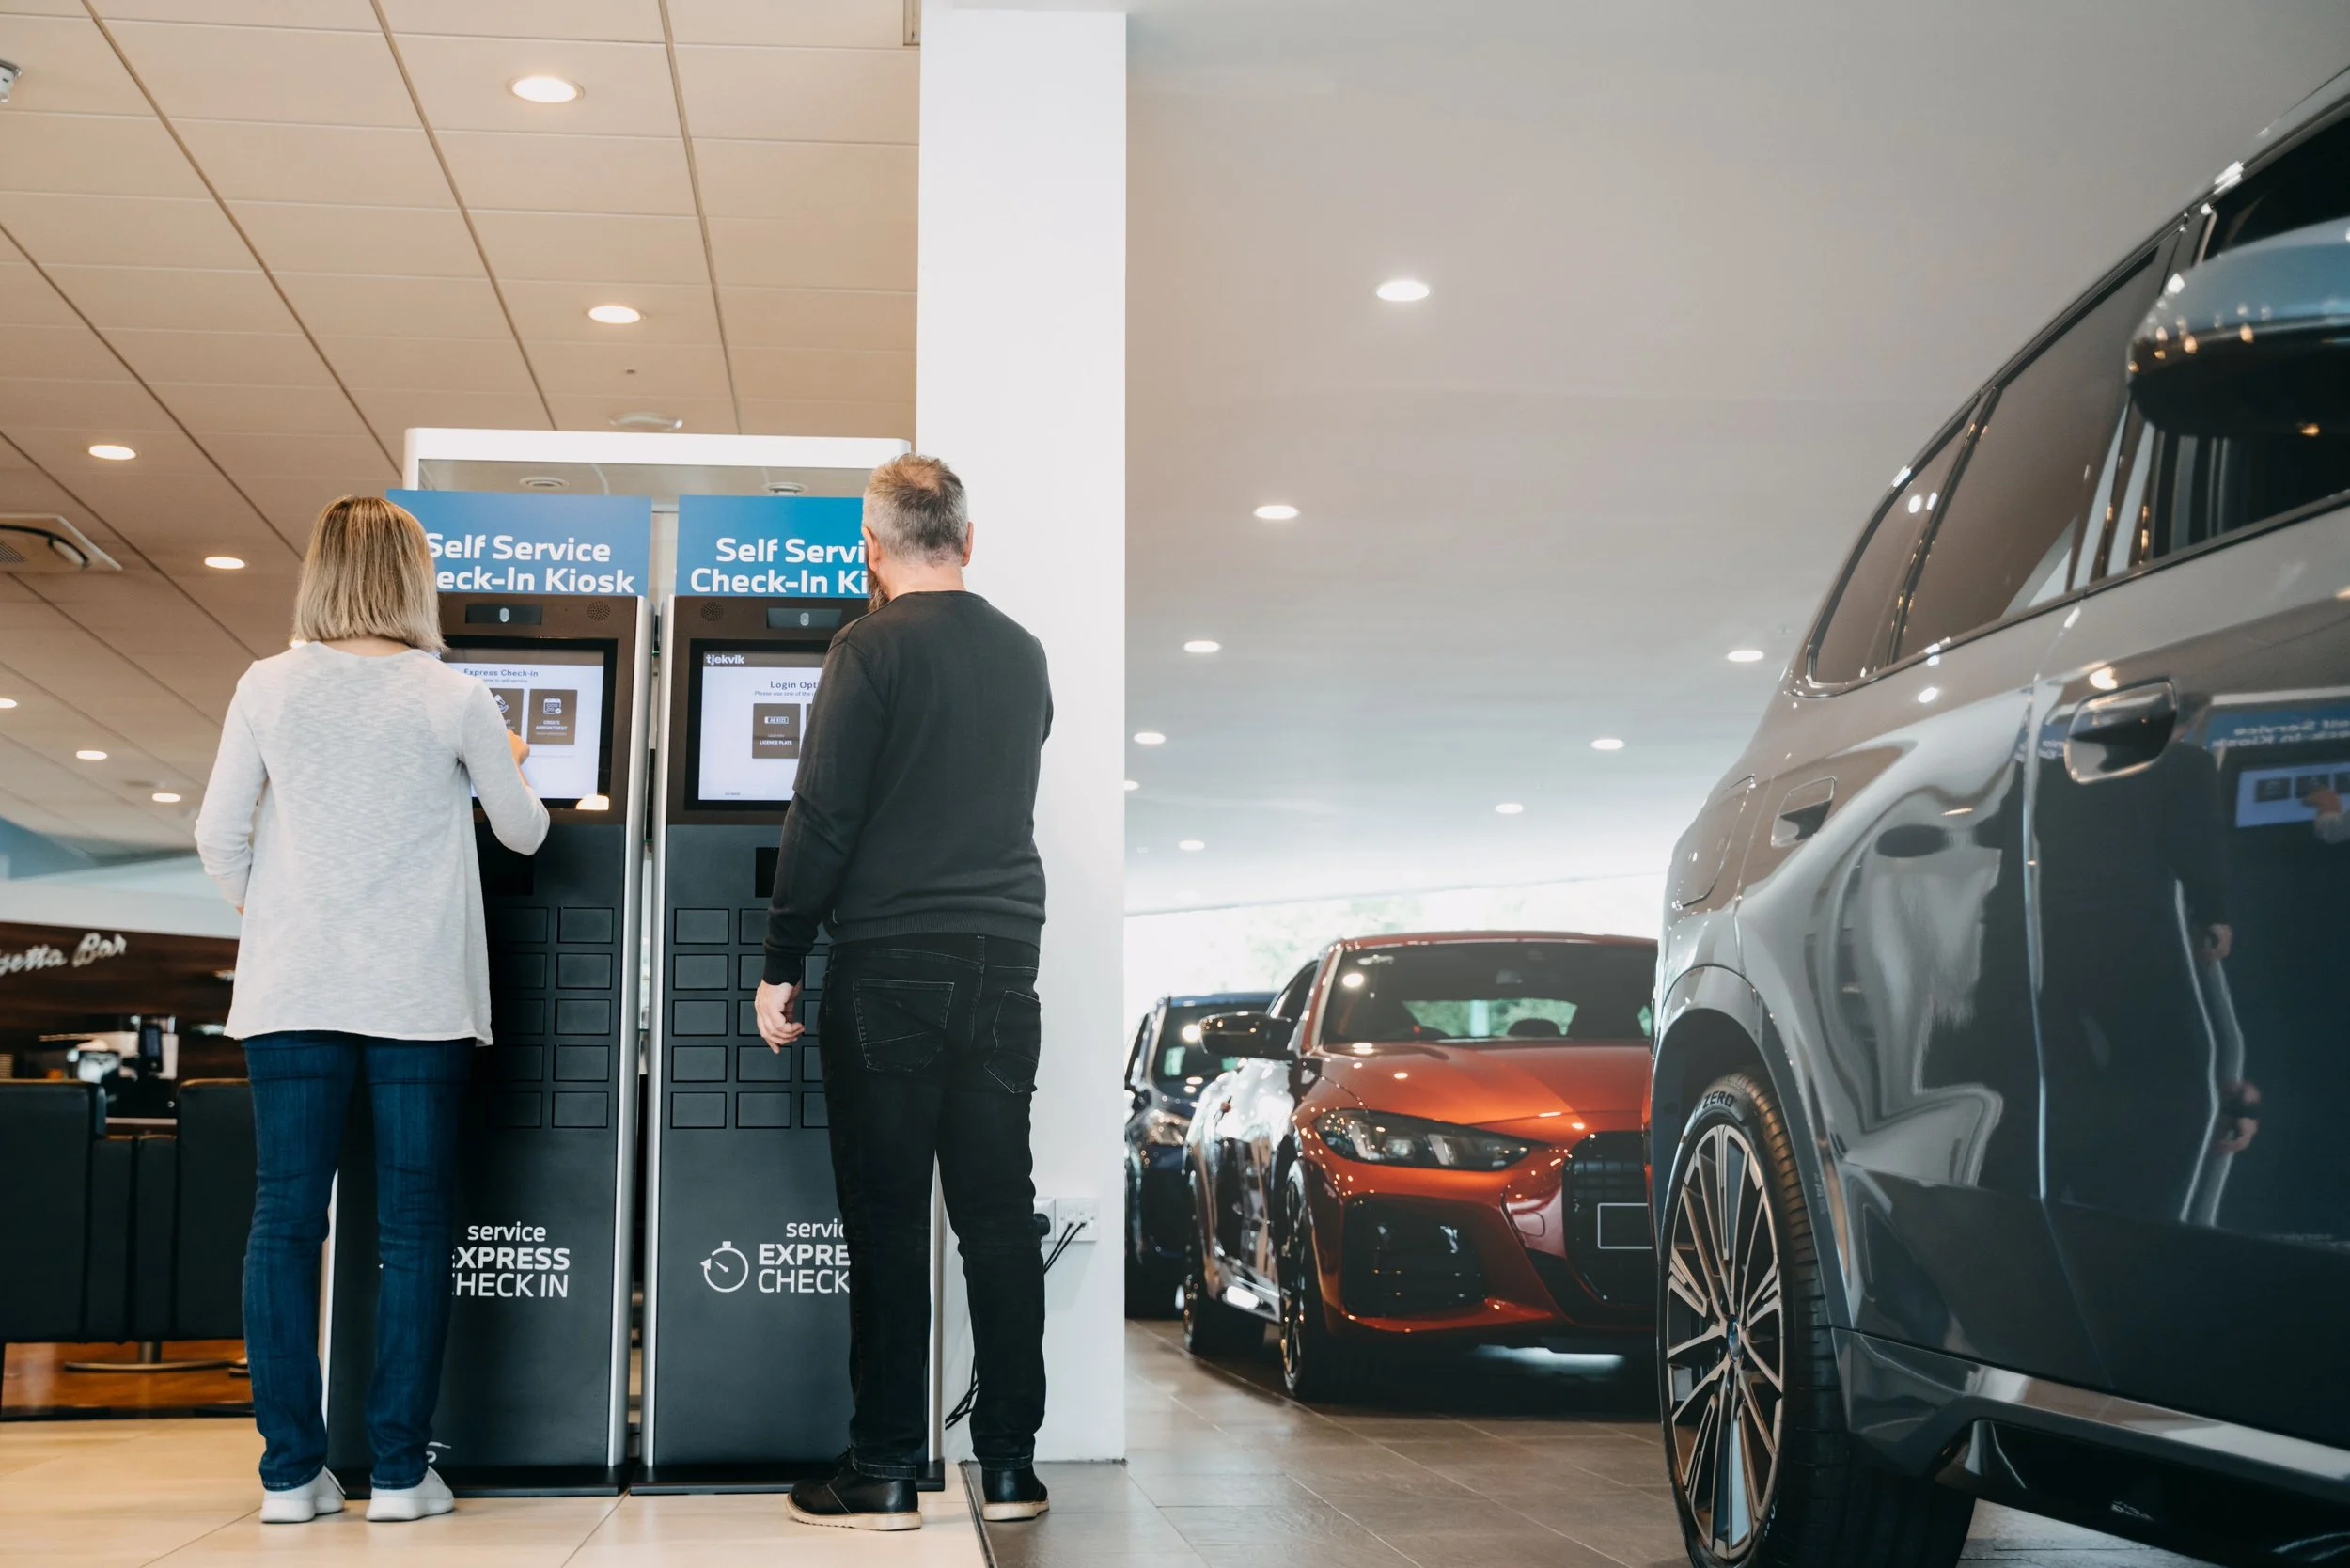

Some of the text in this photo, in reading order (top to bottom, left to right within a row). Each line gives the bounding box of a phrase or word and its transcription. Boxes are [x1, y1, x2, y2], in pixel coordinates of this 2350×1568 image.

[426, 532, 611, 562] Self Service
[715, 537, 866, 564] Self Servi
[436, 566, 635, 594] eck-In Kiosk
[690, 567, 828, 594] Check-In
[705, 654, 744, 666] tjekvik
[500, 668, 539, 677] Check-in
[770, 681, 796, 690] Login
[0, 932, 127, 977] setta Bar
[1702, 1090, 1735, 1109] ZERO
[467, 1220, 547, 1242] service
[786, 1217, 844, 1238] servi
[452, 1247, 571, 1271] XPRESS
[759, 1243, 852, 1266] EXPRE
[452, 1272, 569, 1298] HECK IN
[758, 1268, 850, 1294] CHECK
